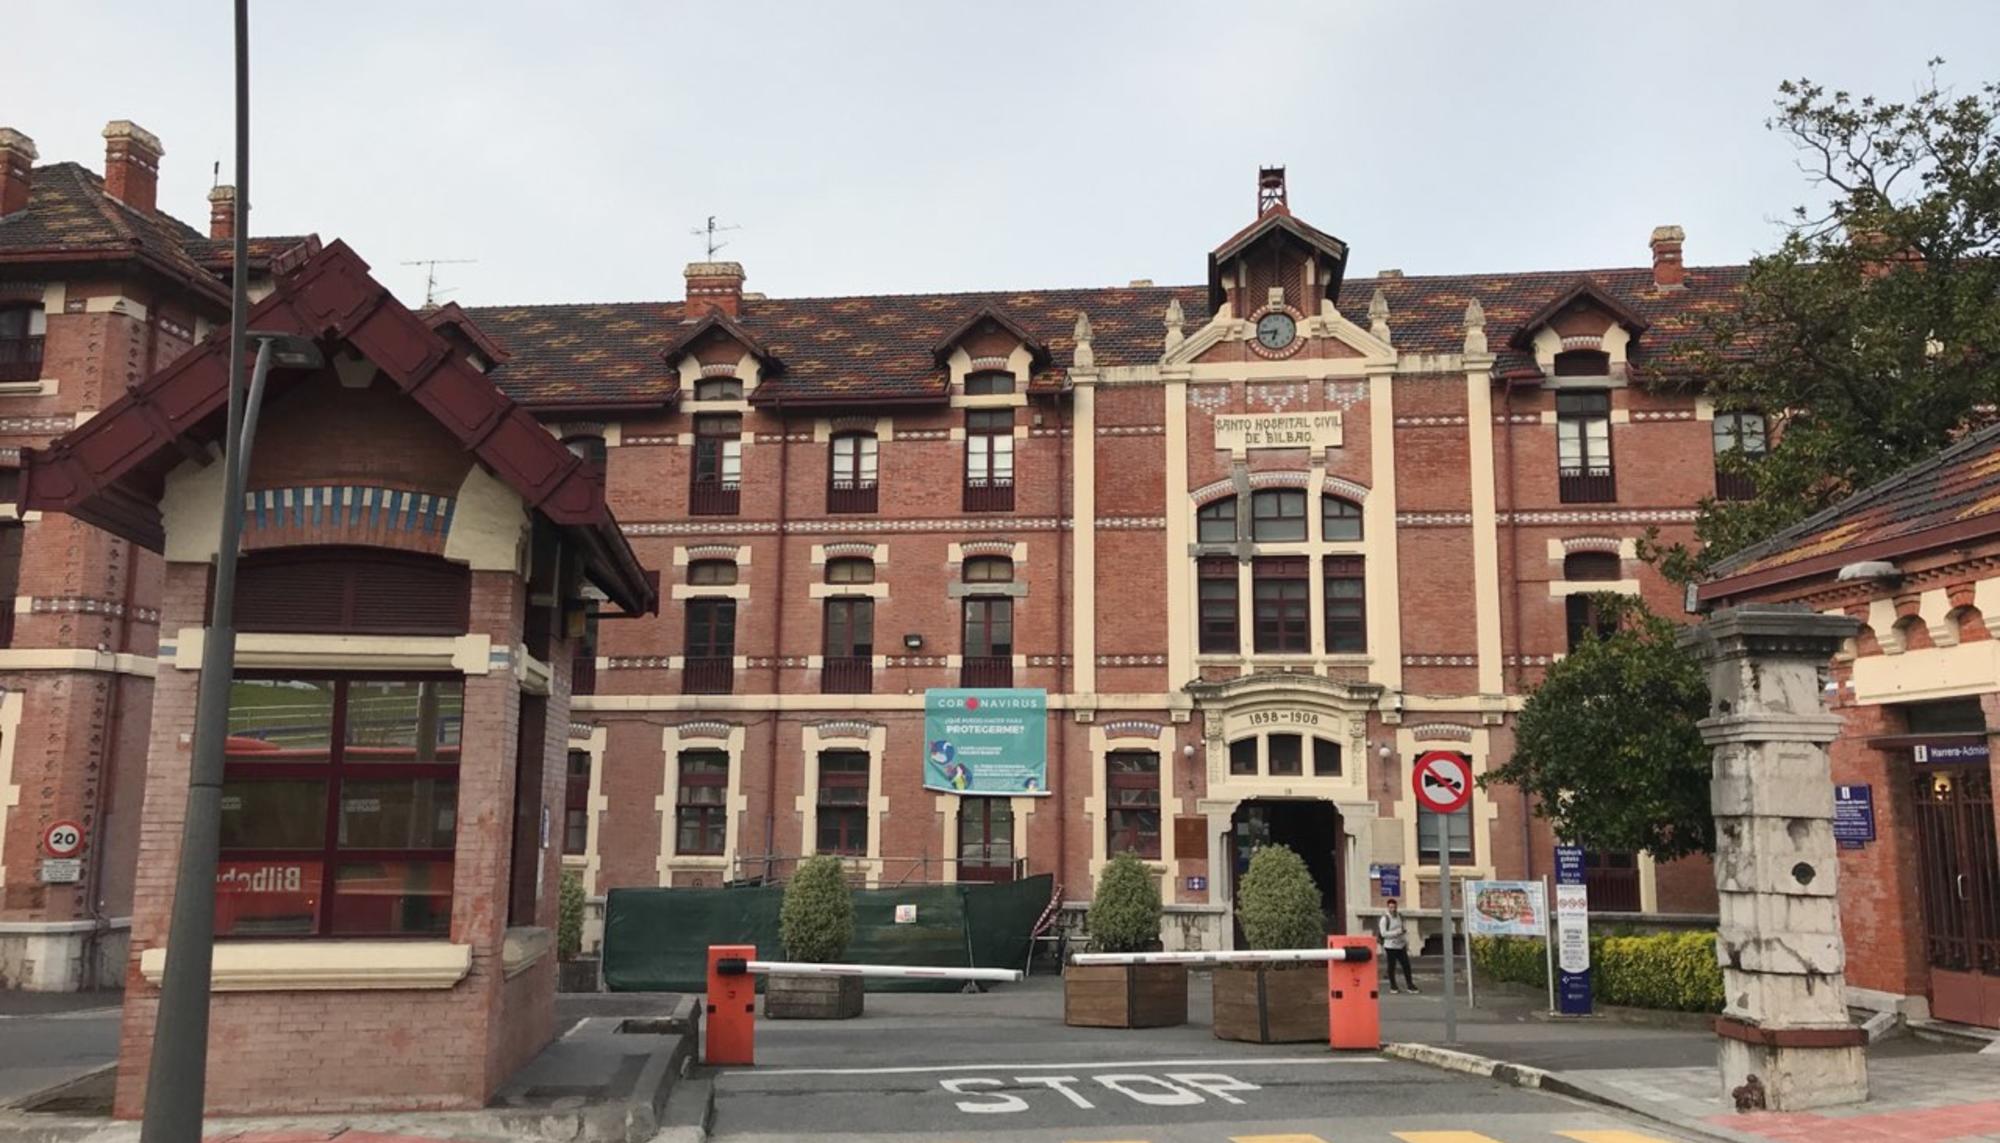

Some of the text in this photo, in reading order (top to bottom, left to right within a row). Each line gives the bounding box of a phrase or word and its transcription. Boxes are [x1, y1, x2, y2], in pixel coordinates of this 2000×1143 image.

[1215, 415, 1341, 432] SANTO HOSPITAL CIVIL
[1245, 433, 1260, 444] DE
[1249, 711, 1319, 725] 1898-1908
[946, 725, 1025, 734] PROTEGERME?
[52, 832, 76, 845] 20
[939, 1072, 1262, 1113] STOP
